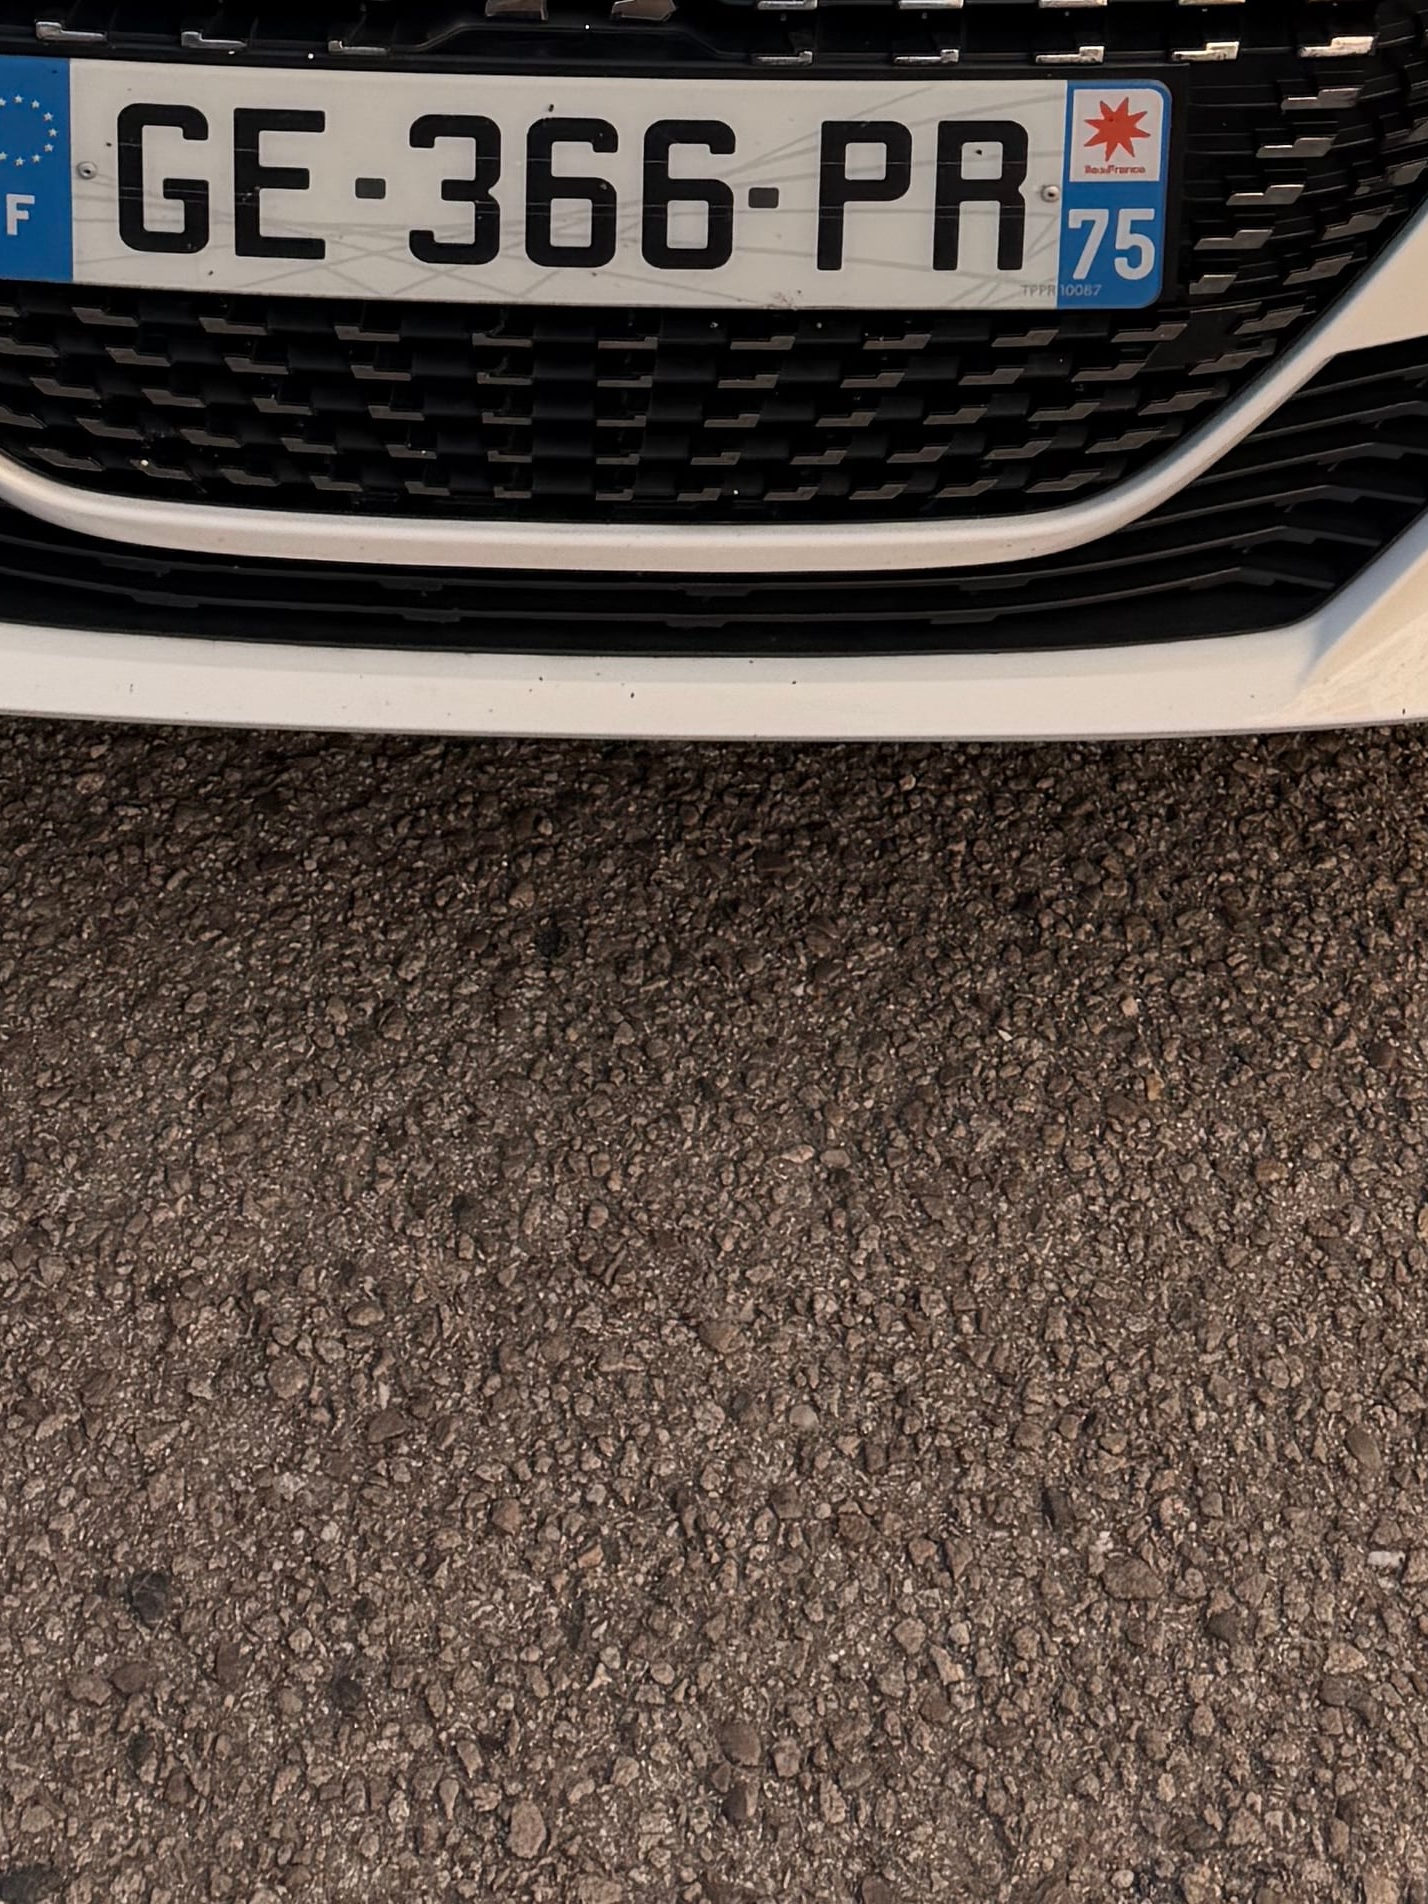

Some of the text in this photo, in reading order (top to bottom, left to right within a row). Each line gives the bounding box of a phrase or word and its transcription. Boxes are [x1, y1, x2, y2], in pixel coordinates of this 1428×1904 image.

[6, 193, 35, 236] F
[116, 102, 1030, 271] GE-366-PR
[1068, 208, 1156, 280] 75
